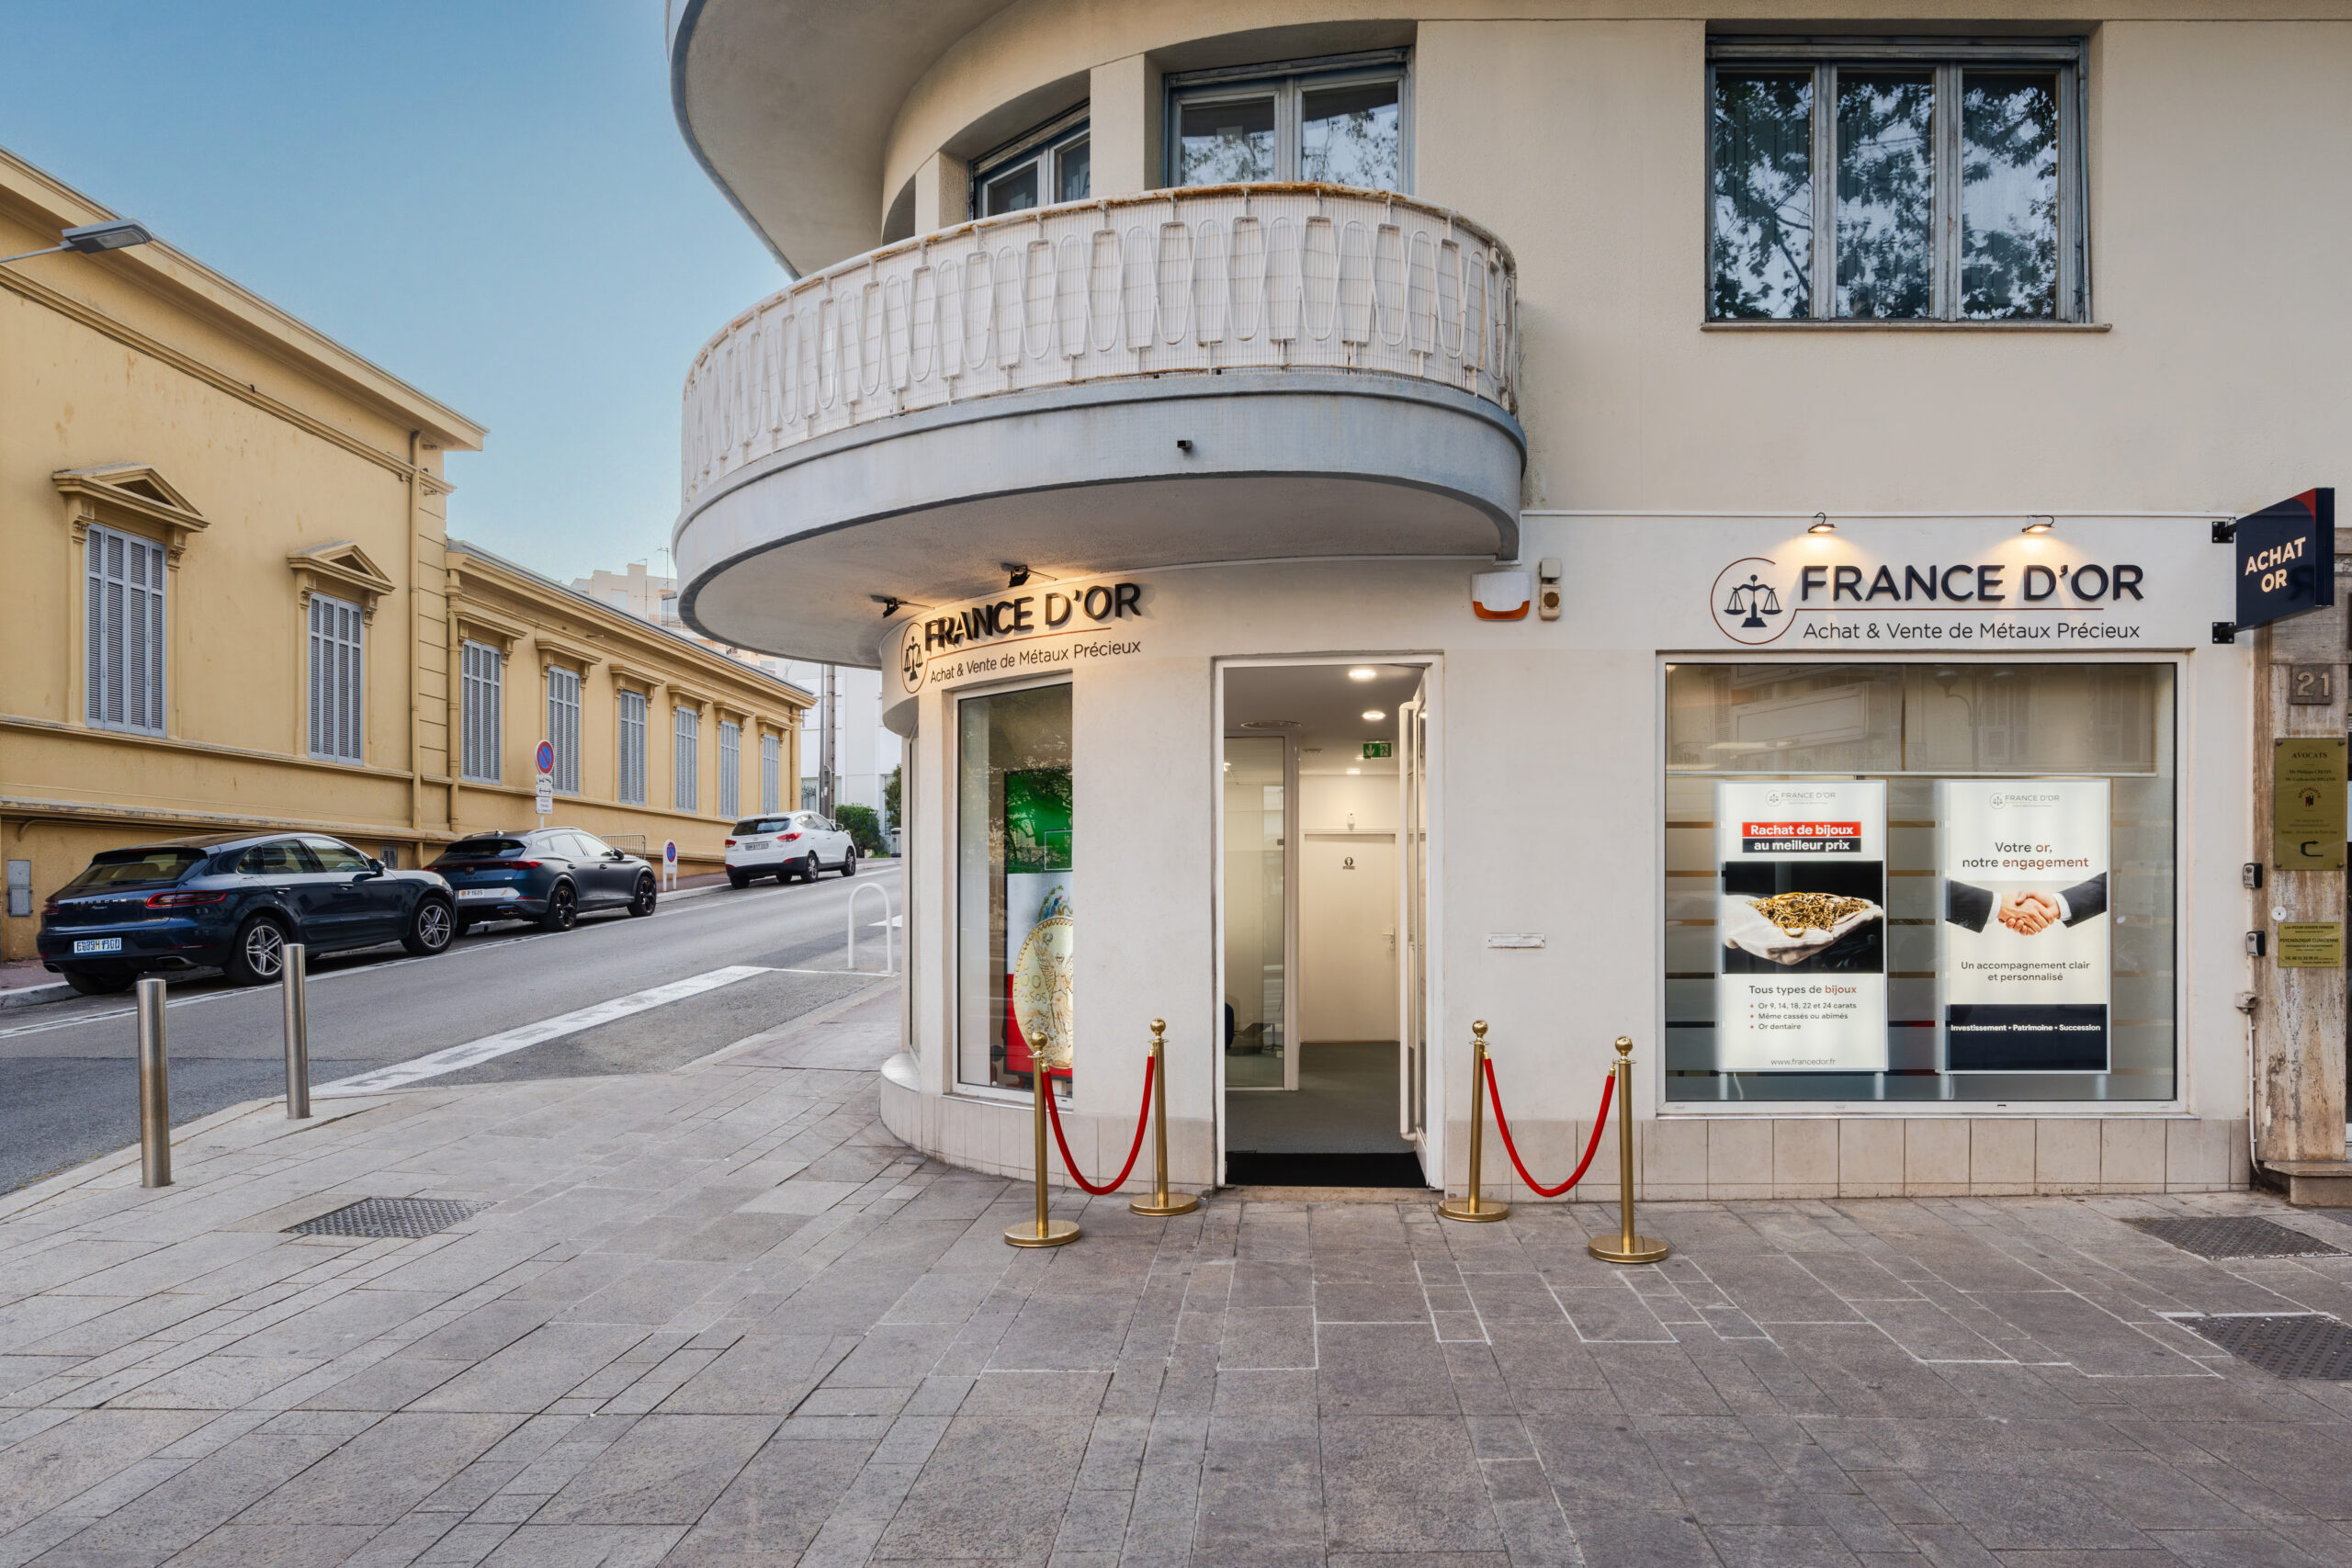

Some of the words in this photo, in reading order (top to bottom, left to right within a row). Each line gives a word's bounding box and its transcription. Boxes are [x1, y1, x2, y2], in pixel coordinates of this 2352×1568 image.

[2245, 536, 2306, 576] ACHAT
[1801, 564, 2006, 603] FRANCE
[2024, 563, 2144, 603] D'OR
[2261, 569, 2288, 592] OR
[925, 596, 1035, 652] FRANCE
[1046, 582, 1141, 626] D'OR
[1803, 623, 1860, 639] Achat
[1867, 624, 1880, 639] &
[1885, 623, 1942, 639] Vente
[1949, 622, 1973, 639] de
[1982, 622, 2050, 639] Métaux
[2057, 622, 2141, 639] Précieux
[931, 668, 955, 683] Achat
[956, 665, 964, 677] &
[967, 658, 997, 674] Vente
[1001, 653, 1015, 668] de
[1019, 648, 1069, 665] Métaux
[1074, 641, 1141, 659] Précieux
[2297, 671, 2329, 696] 21
[1750, 825, 1794, 835] Rachat
[1796, 825, 1812, 835] de
[1815, 825, 1853, 837] bijoux
[1754, 841, 1769, 851] au
[1772, 840, 1823, 851] meilleur
[1826, 840, 1849, 852] prix
[1995, 842, 2031, 852] Votre
[2035, 844, 2052, 853] or,
[1962, 859, 1999, 867] notre
[2002, 858, 2088, 870] engagement
[1976, 962, 2066, 972] accompagnement
[2068, 961, 2090, 969] clair
[2000, 973, 2064, 982] personnalisé
[1749, 986, 1774, 994] Tous
[1776, 986, 1806, 996] types
[1809, 986, 1822, 994] de
[1825, 986, 1857, 996] bijoux
